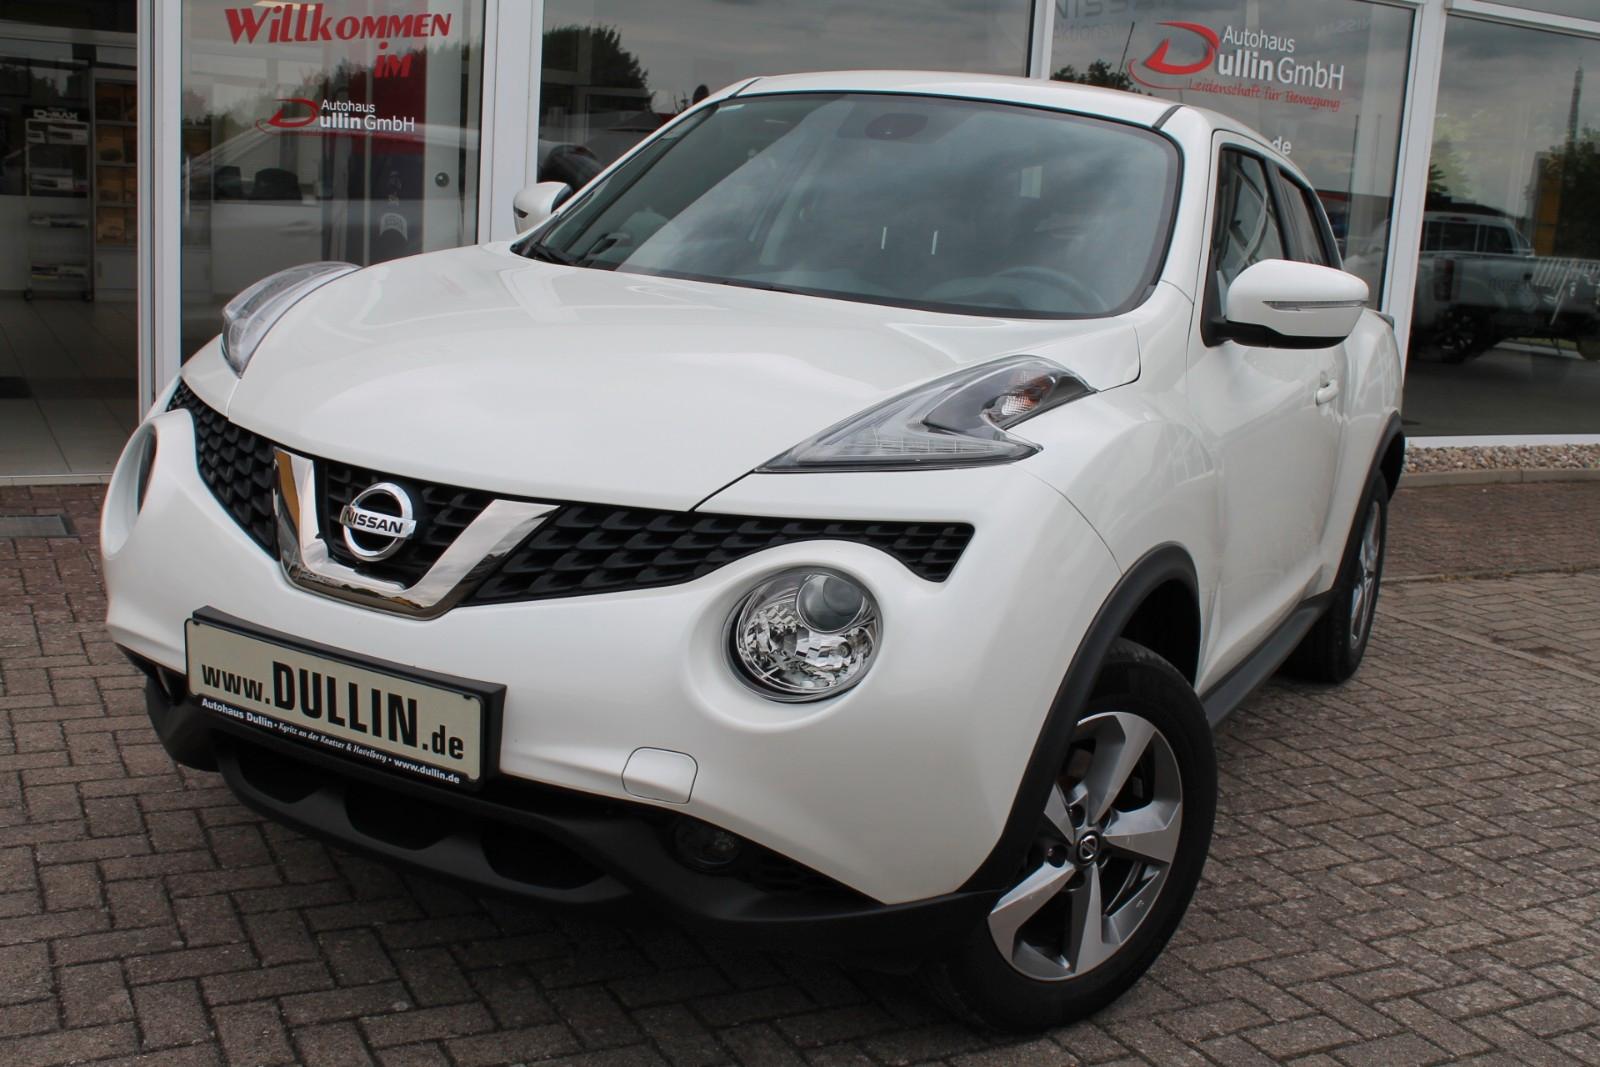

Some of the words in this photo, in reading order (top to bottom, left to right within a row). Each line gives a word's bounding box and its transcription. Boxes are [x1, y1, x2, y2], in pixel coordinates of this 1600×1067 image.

[1222, 25, 1296, 53] Autohaus
[1276, 57, 1344, 91] GmbH
[320, 99, 376, 113] Autohaus
[363, 115, 415, 133] GmbH
[345, 510, 404, 534] NISSAN
[201, 660, 464, 760] www.DULLIN.de
[201, 697, 244, 720] Autohaus
[246, 711, 273, 729] Dullin
[308, 731, 319, 741] der
[393, 759, 460, 784] www.dullin.de
